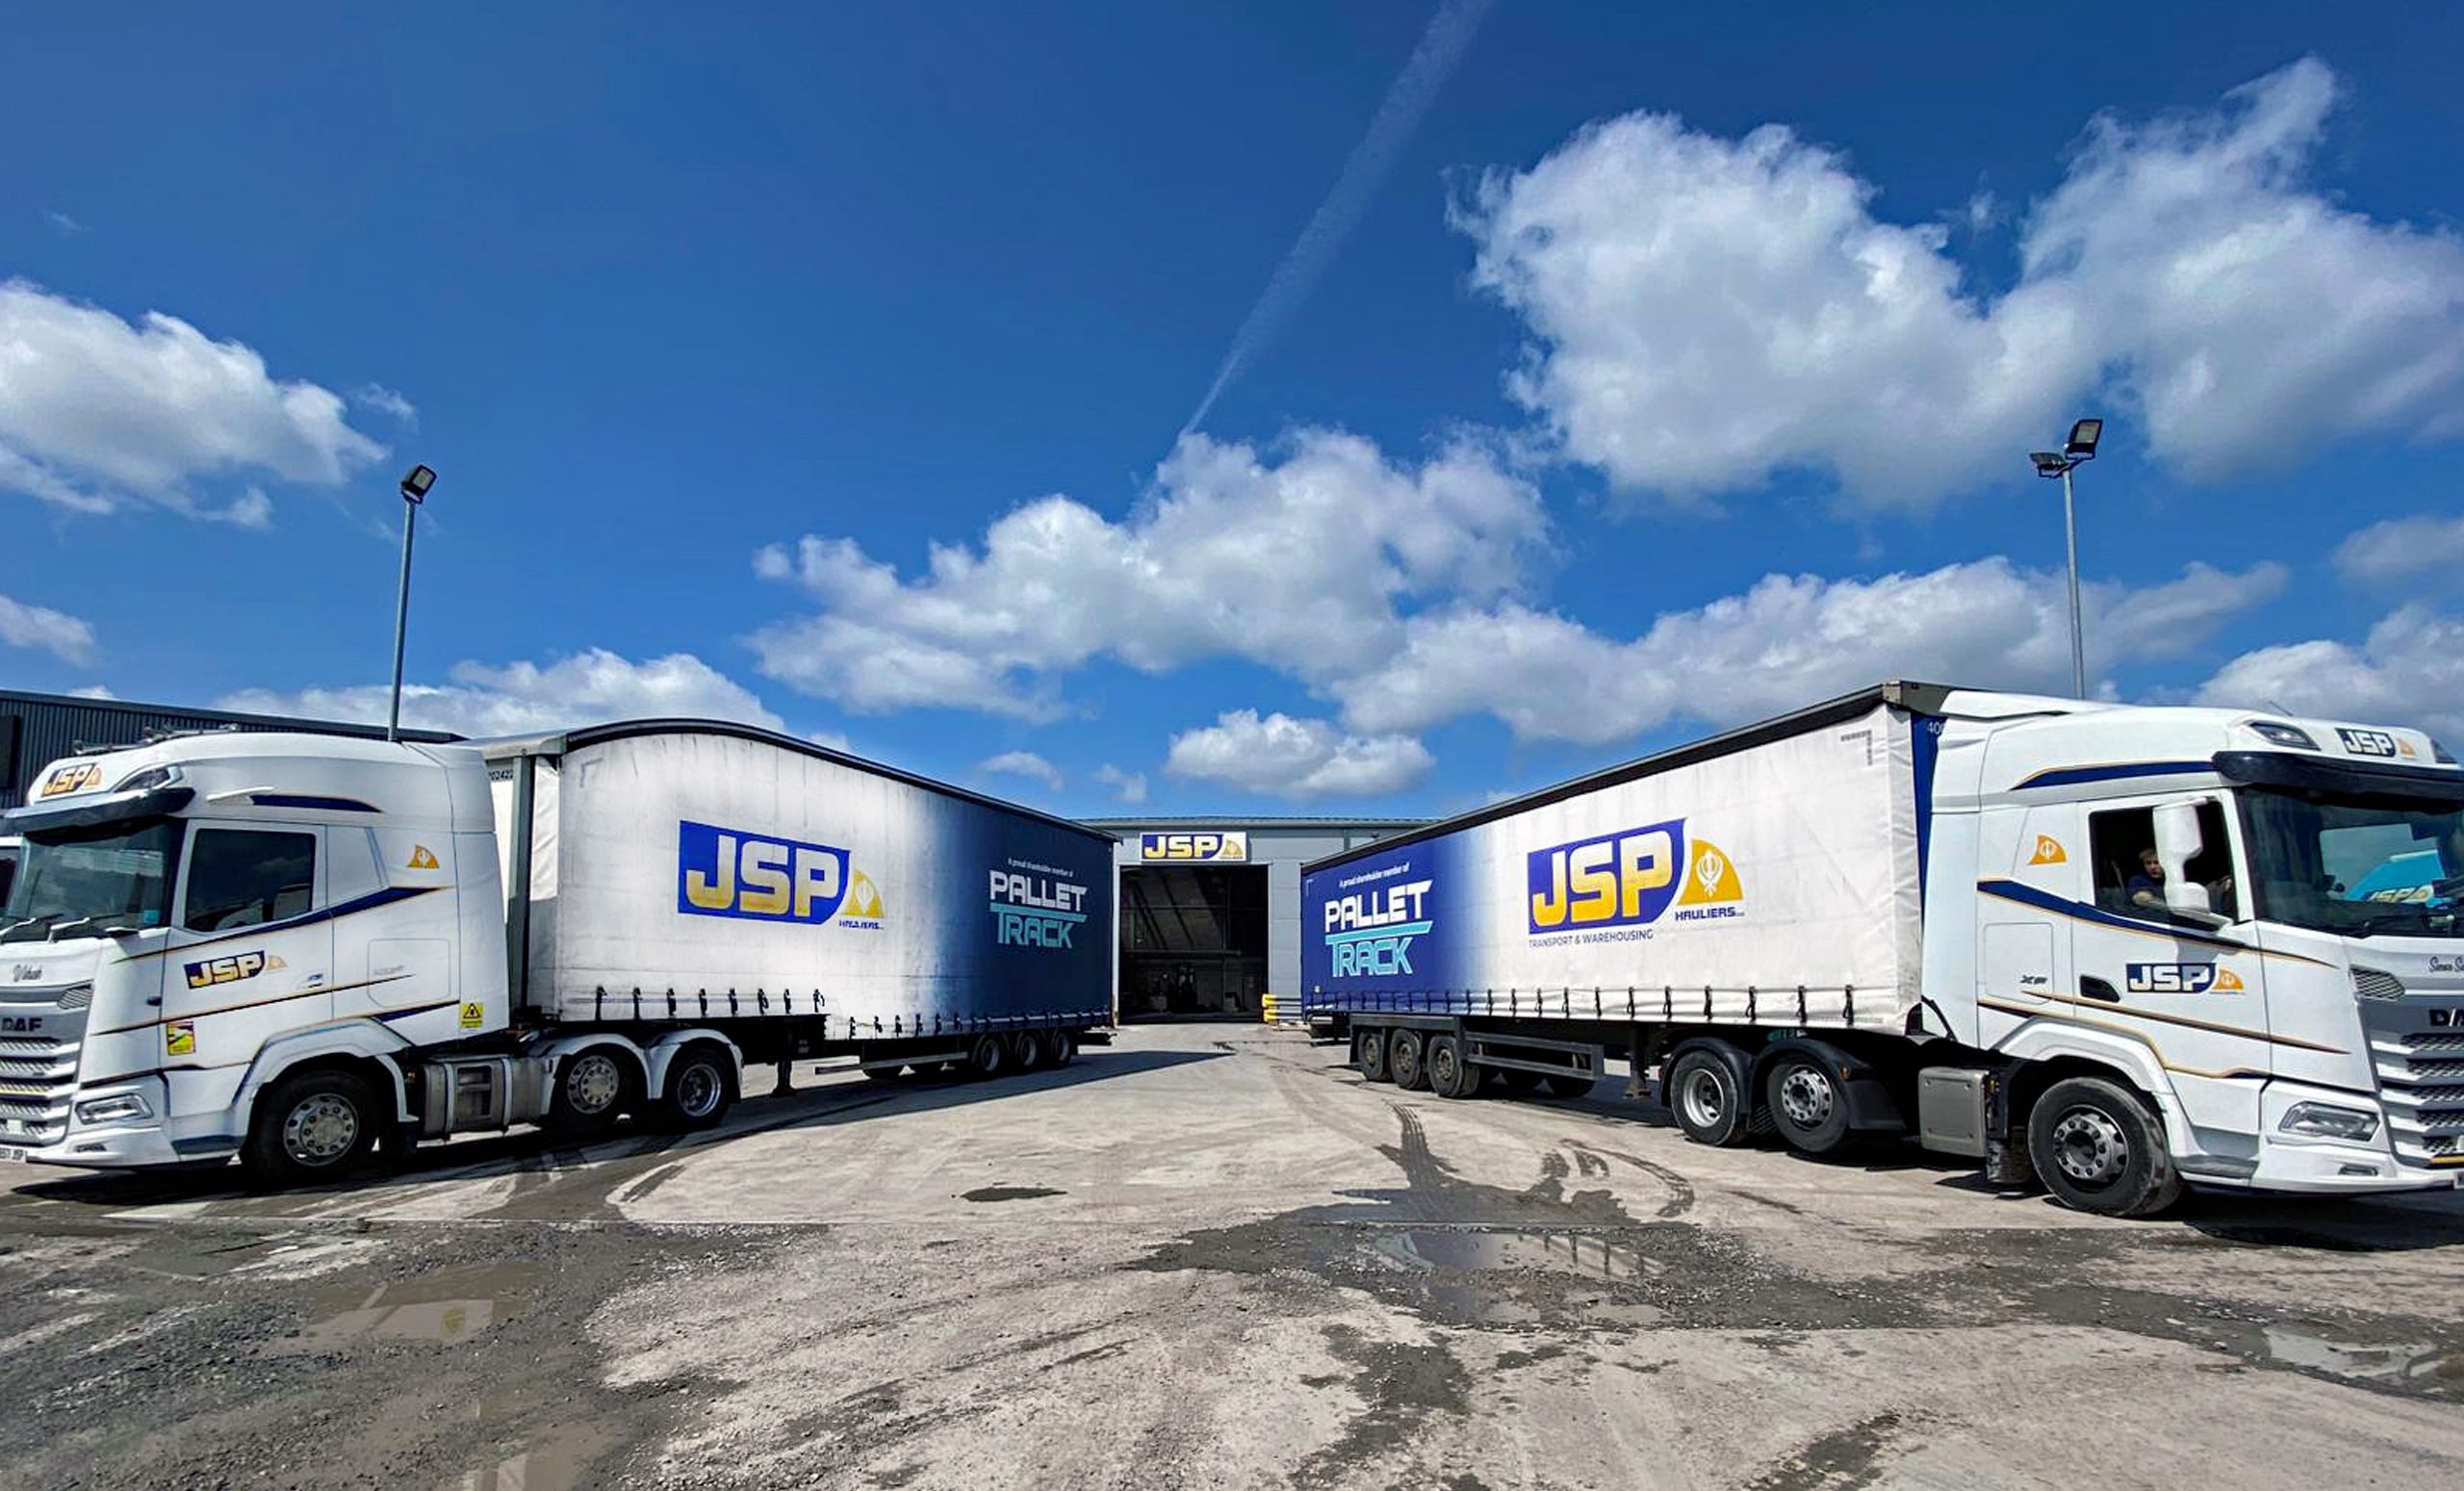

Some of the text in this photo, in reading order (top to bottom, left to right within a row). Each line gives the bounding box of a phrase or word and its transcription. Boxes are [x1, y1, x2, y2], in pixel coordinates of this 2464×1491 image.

[2345, 731, 2394, 755] JSP
[44, 763, 93, 793] JSP
[1144, 835, 1219, 859] JSP
[685, 835, 840, 918] JSP
[989, 870, 1088, 913] PALLET
[1532, 830, 1673, 927] JSP
[1324, 880, 1433, 933] PALLET
[1676, 907, 1736, 921] HAULIERS
[989, 903, 1088, 949] TRACK
[1529, 928, 1654, 948] TRANSPORT & WAREHOUSING
[1325, 920, 1433, 978] TRACK
[191, 954, 261, 987] JSP
[2130, 964, 2210, 991] JSP
[2, 1017, 42, 1032] DAF
